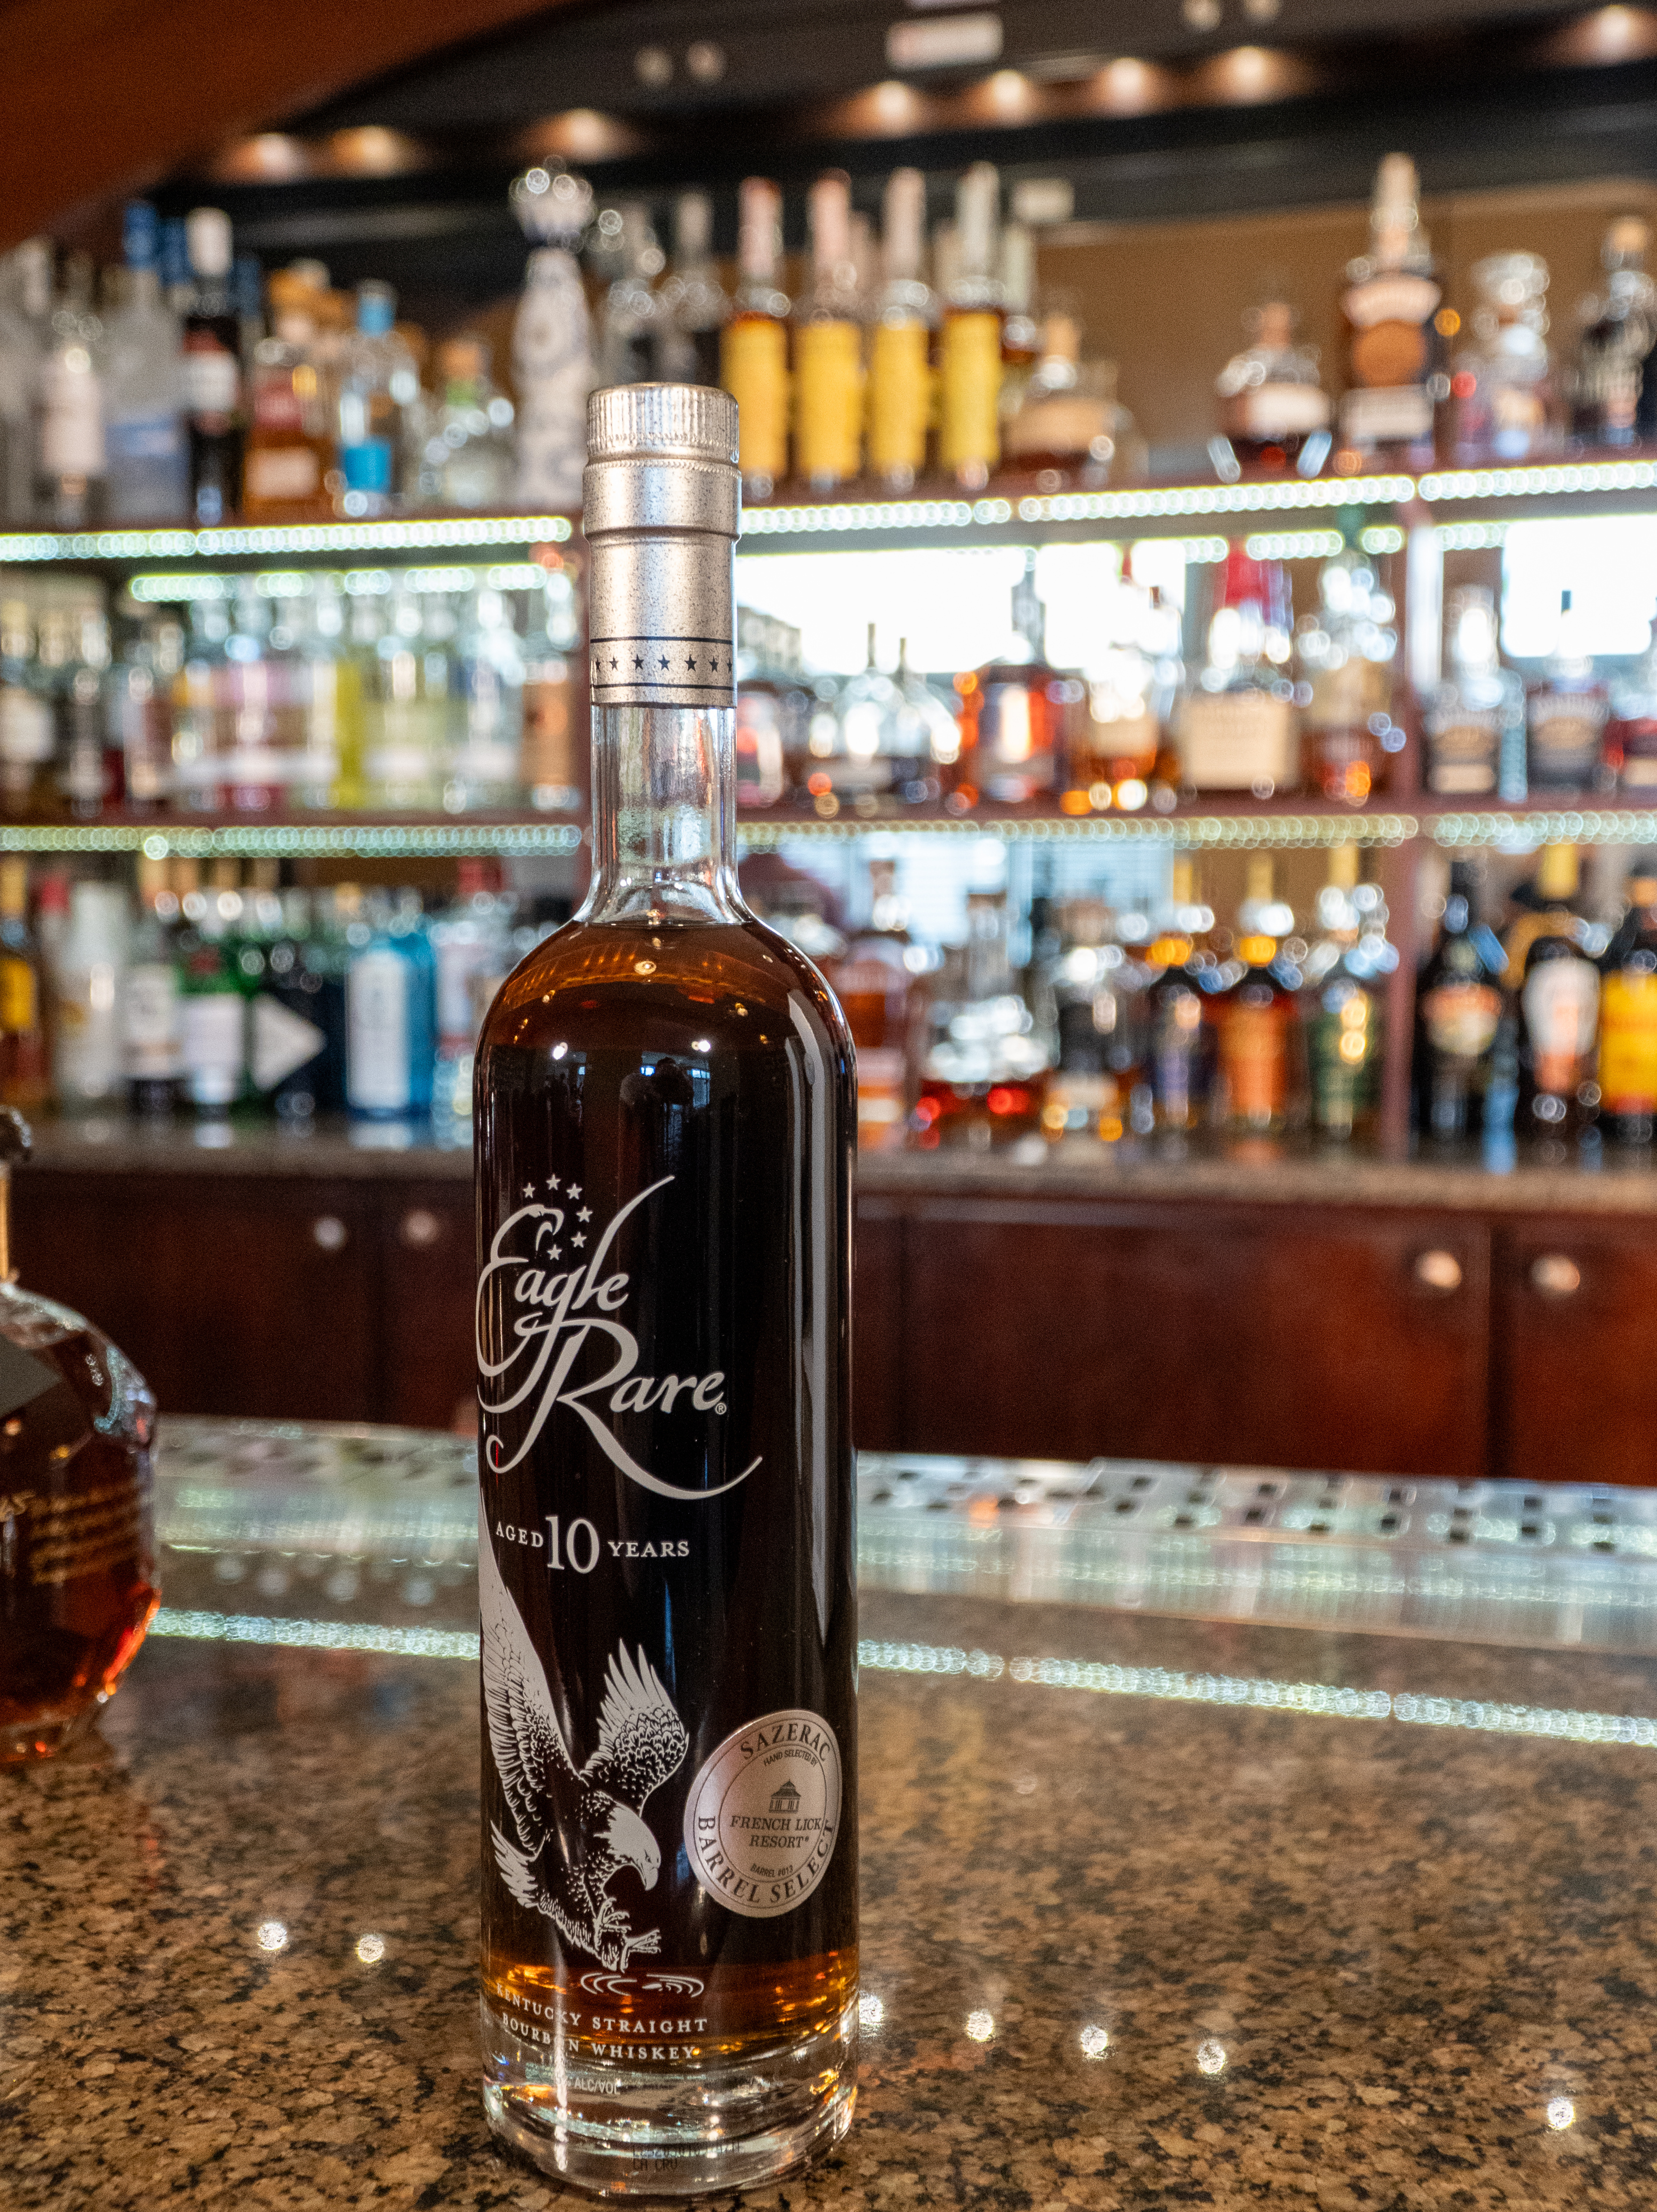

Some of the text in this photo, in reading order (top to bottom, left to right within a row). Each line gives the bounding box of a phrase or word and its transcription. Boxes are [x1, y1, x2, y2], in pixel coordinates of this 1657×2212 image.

[475, 1175, 675, 1413] Eagle
[496, 1515, 690, 1574] AGED 10 YEARS
[740, 1722, 830, 1762] SAZERAC
[763, 1748, 818, 1767] HAND SELECTED BY
[730, 1816, 822, 1831] FRENCH LICK
[698, 1816, 835, 1903] BARREL SELECT
[750, 1863, 775, 1878] BARREL
[497, 1982, 707, 2033] KENTUCKY STRAIGHT
[503, 2013, 695, 2060] BOURBN WHISKEY
[575, 2077, 621, 2095] ALC/VOL
